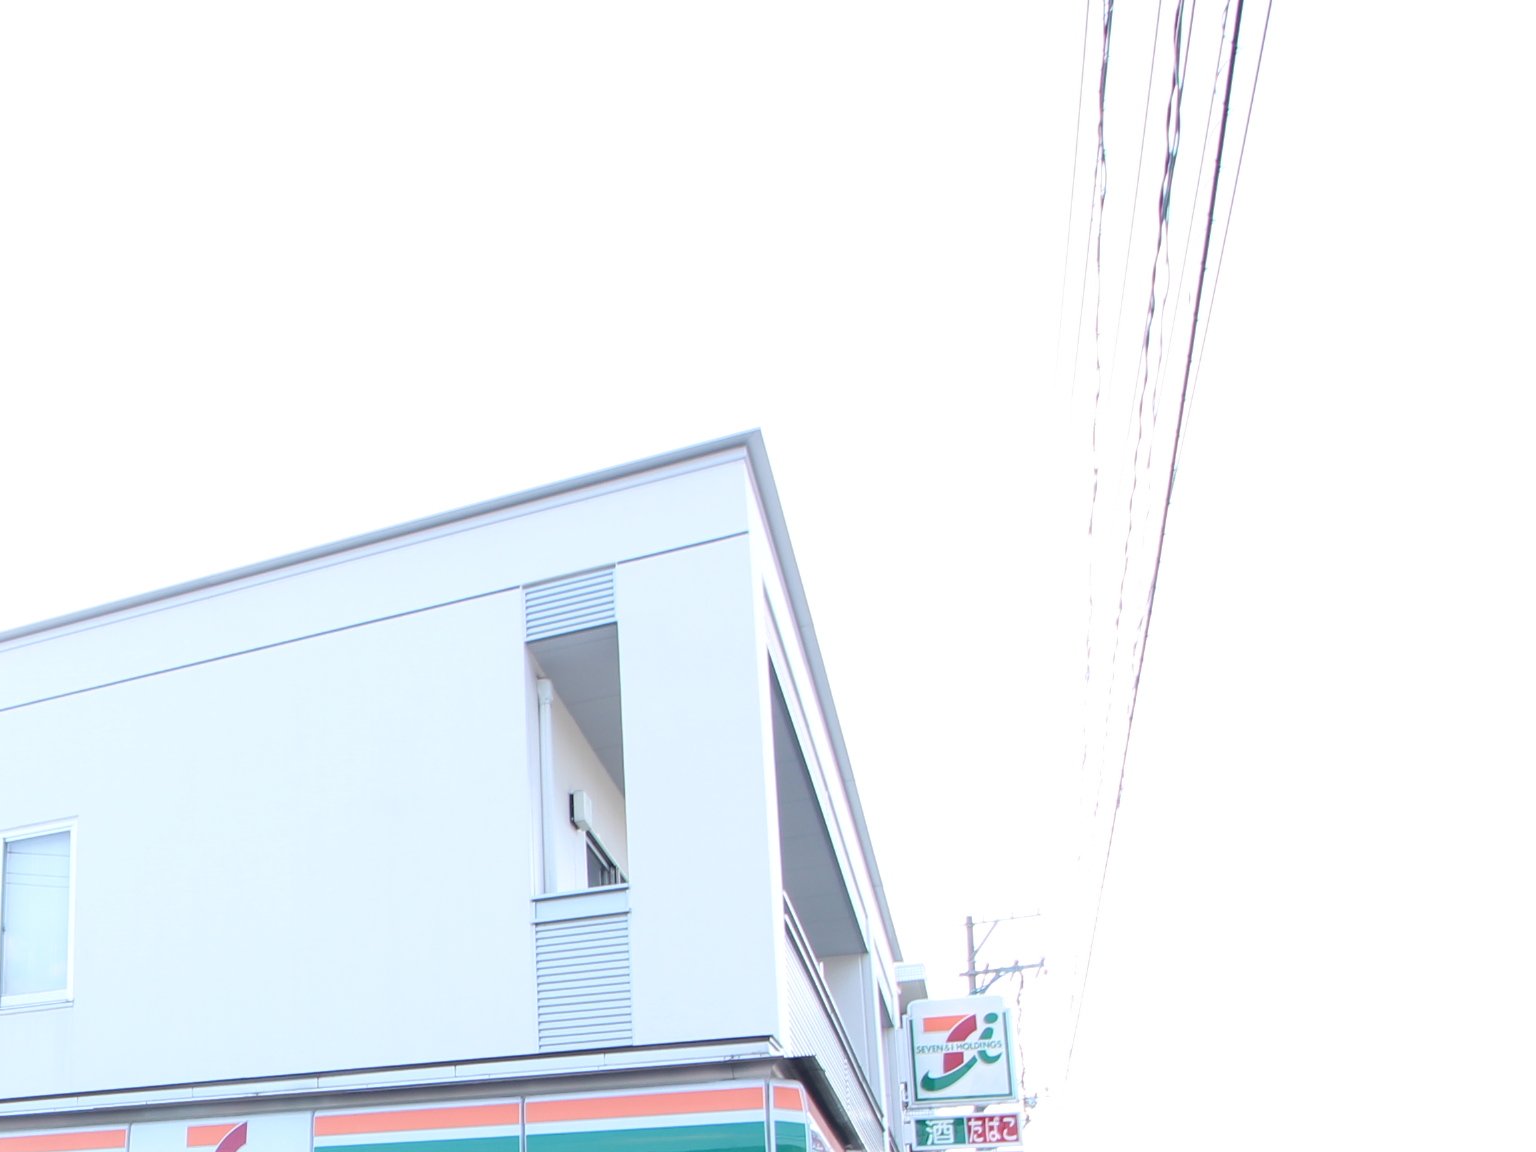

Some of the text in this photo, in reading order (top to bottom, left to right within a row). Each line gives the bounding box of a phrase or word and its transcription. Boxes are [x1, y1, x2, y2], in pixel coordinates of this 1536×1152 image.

[956, 1040, 1002, 1051] HOLDINGS
[926, 1119, 954, 1145] 酒
[968, 1117, 1017, 1143] たばこ
